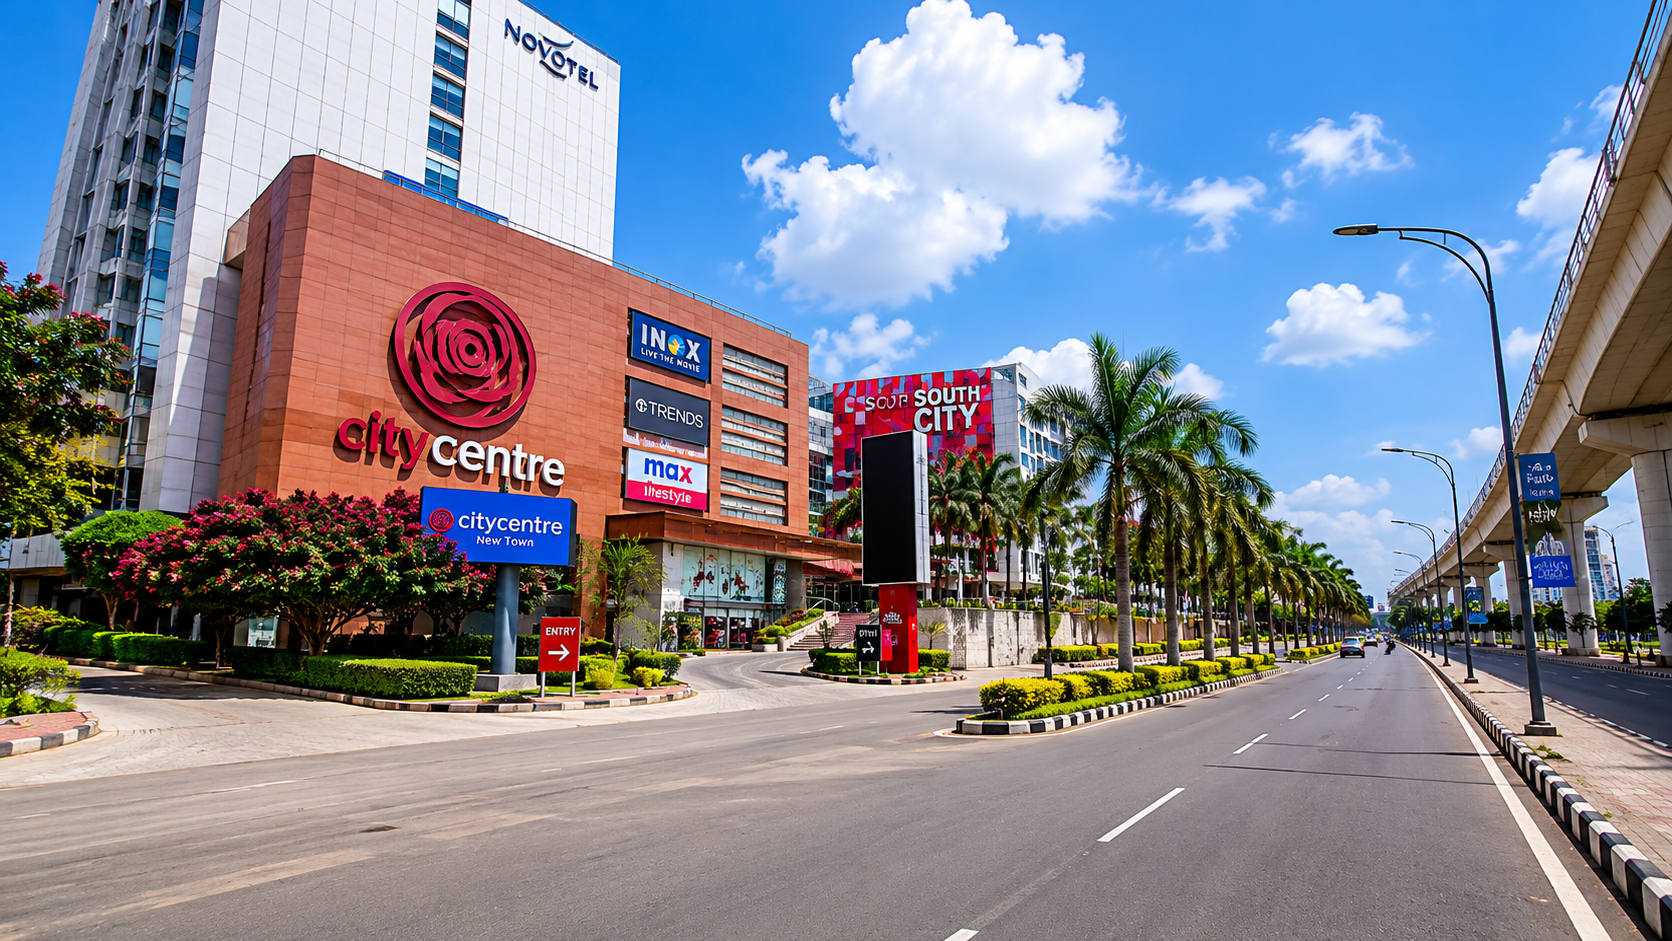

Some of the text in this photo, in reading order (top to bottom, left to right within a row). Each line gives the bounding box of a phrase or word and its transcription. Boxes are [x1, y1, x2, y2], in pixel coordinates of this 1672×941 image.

[504, 18, 599, 91] NOVOTEL
[641, 323, 701, 363] INOX
[640, 347, 658, 359] LIVE
[660, 353, 675, 365] THE
[914, 385, 981, 407] SOUTH
[648, 401, 704, 429] TRENDS
[914, 402, 979, 433] CITY
[644, 457, 693, 485] max
[458, 512, 563, 535] citycentre
[476, 535, 534, 547] New Town
[545, 626, 576, 636] ENTRY
